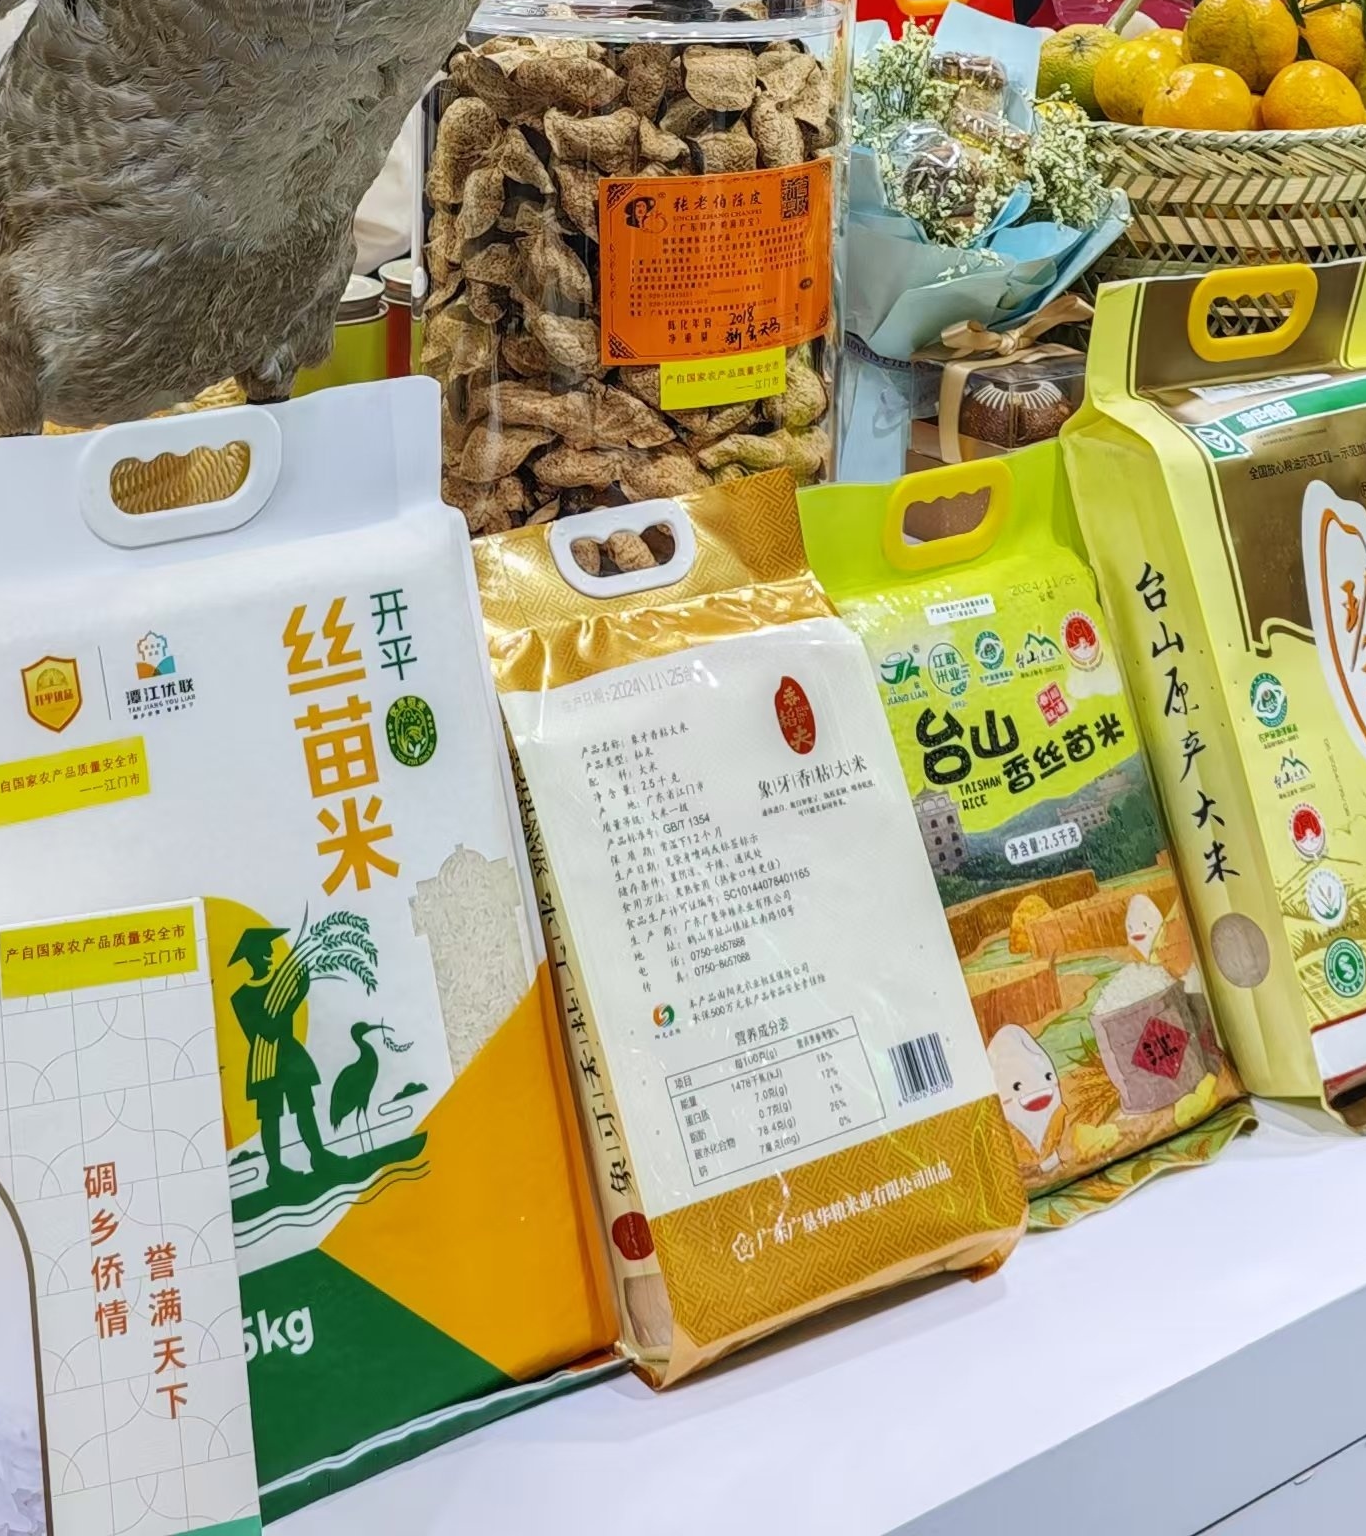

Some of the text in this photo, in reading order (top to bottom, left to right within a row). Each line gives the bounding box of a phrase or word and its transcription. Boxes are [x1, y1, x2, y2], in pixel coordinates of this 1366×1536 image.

[729, 305, 754, 325] 2018
[369, 587, 420, 682] 开平
[281, 594, 402, 898] 丝苗米
[915, 707, 1022, 787] 台山
[957, 774, 1003, 797] TAISHAN
[961, 792, 989, 812] RICE
[688, 813, 711, 829] 1354
[3, 922, 188, 964] 产自国家农产品质量安全市
[734, 1016, 790, 1047] 营养成分表
[82, 1160, 131, 1342] 碉乡侨情
[143, 1241, 191, 1422] 誉满天下
